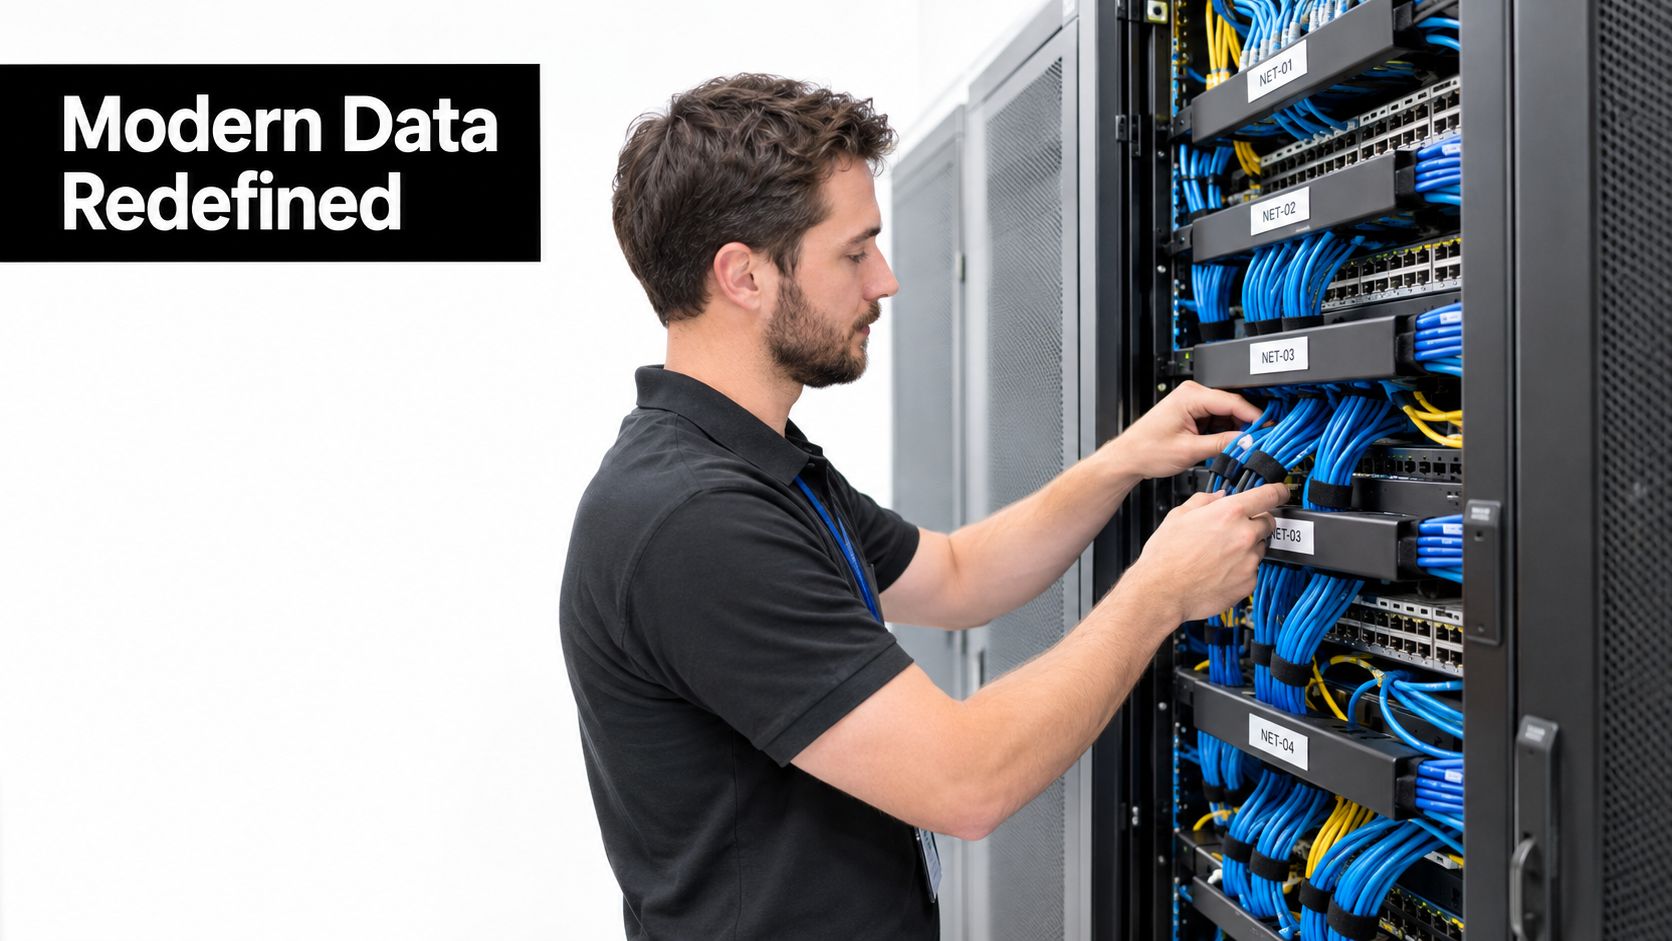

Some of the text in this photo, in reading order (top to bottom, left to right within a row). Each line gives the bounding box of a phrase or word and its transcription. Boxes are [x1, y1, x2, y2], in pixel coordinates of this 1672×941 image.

[1259, 58, 1292, 87] NET-01
[1262, 202, 1295, 223] NET-02
[1262, 348, 1295, 364] NET-03
[1261, 729, 1294, 754] NET-04
